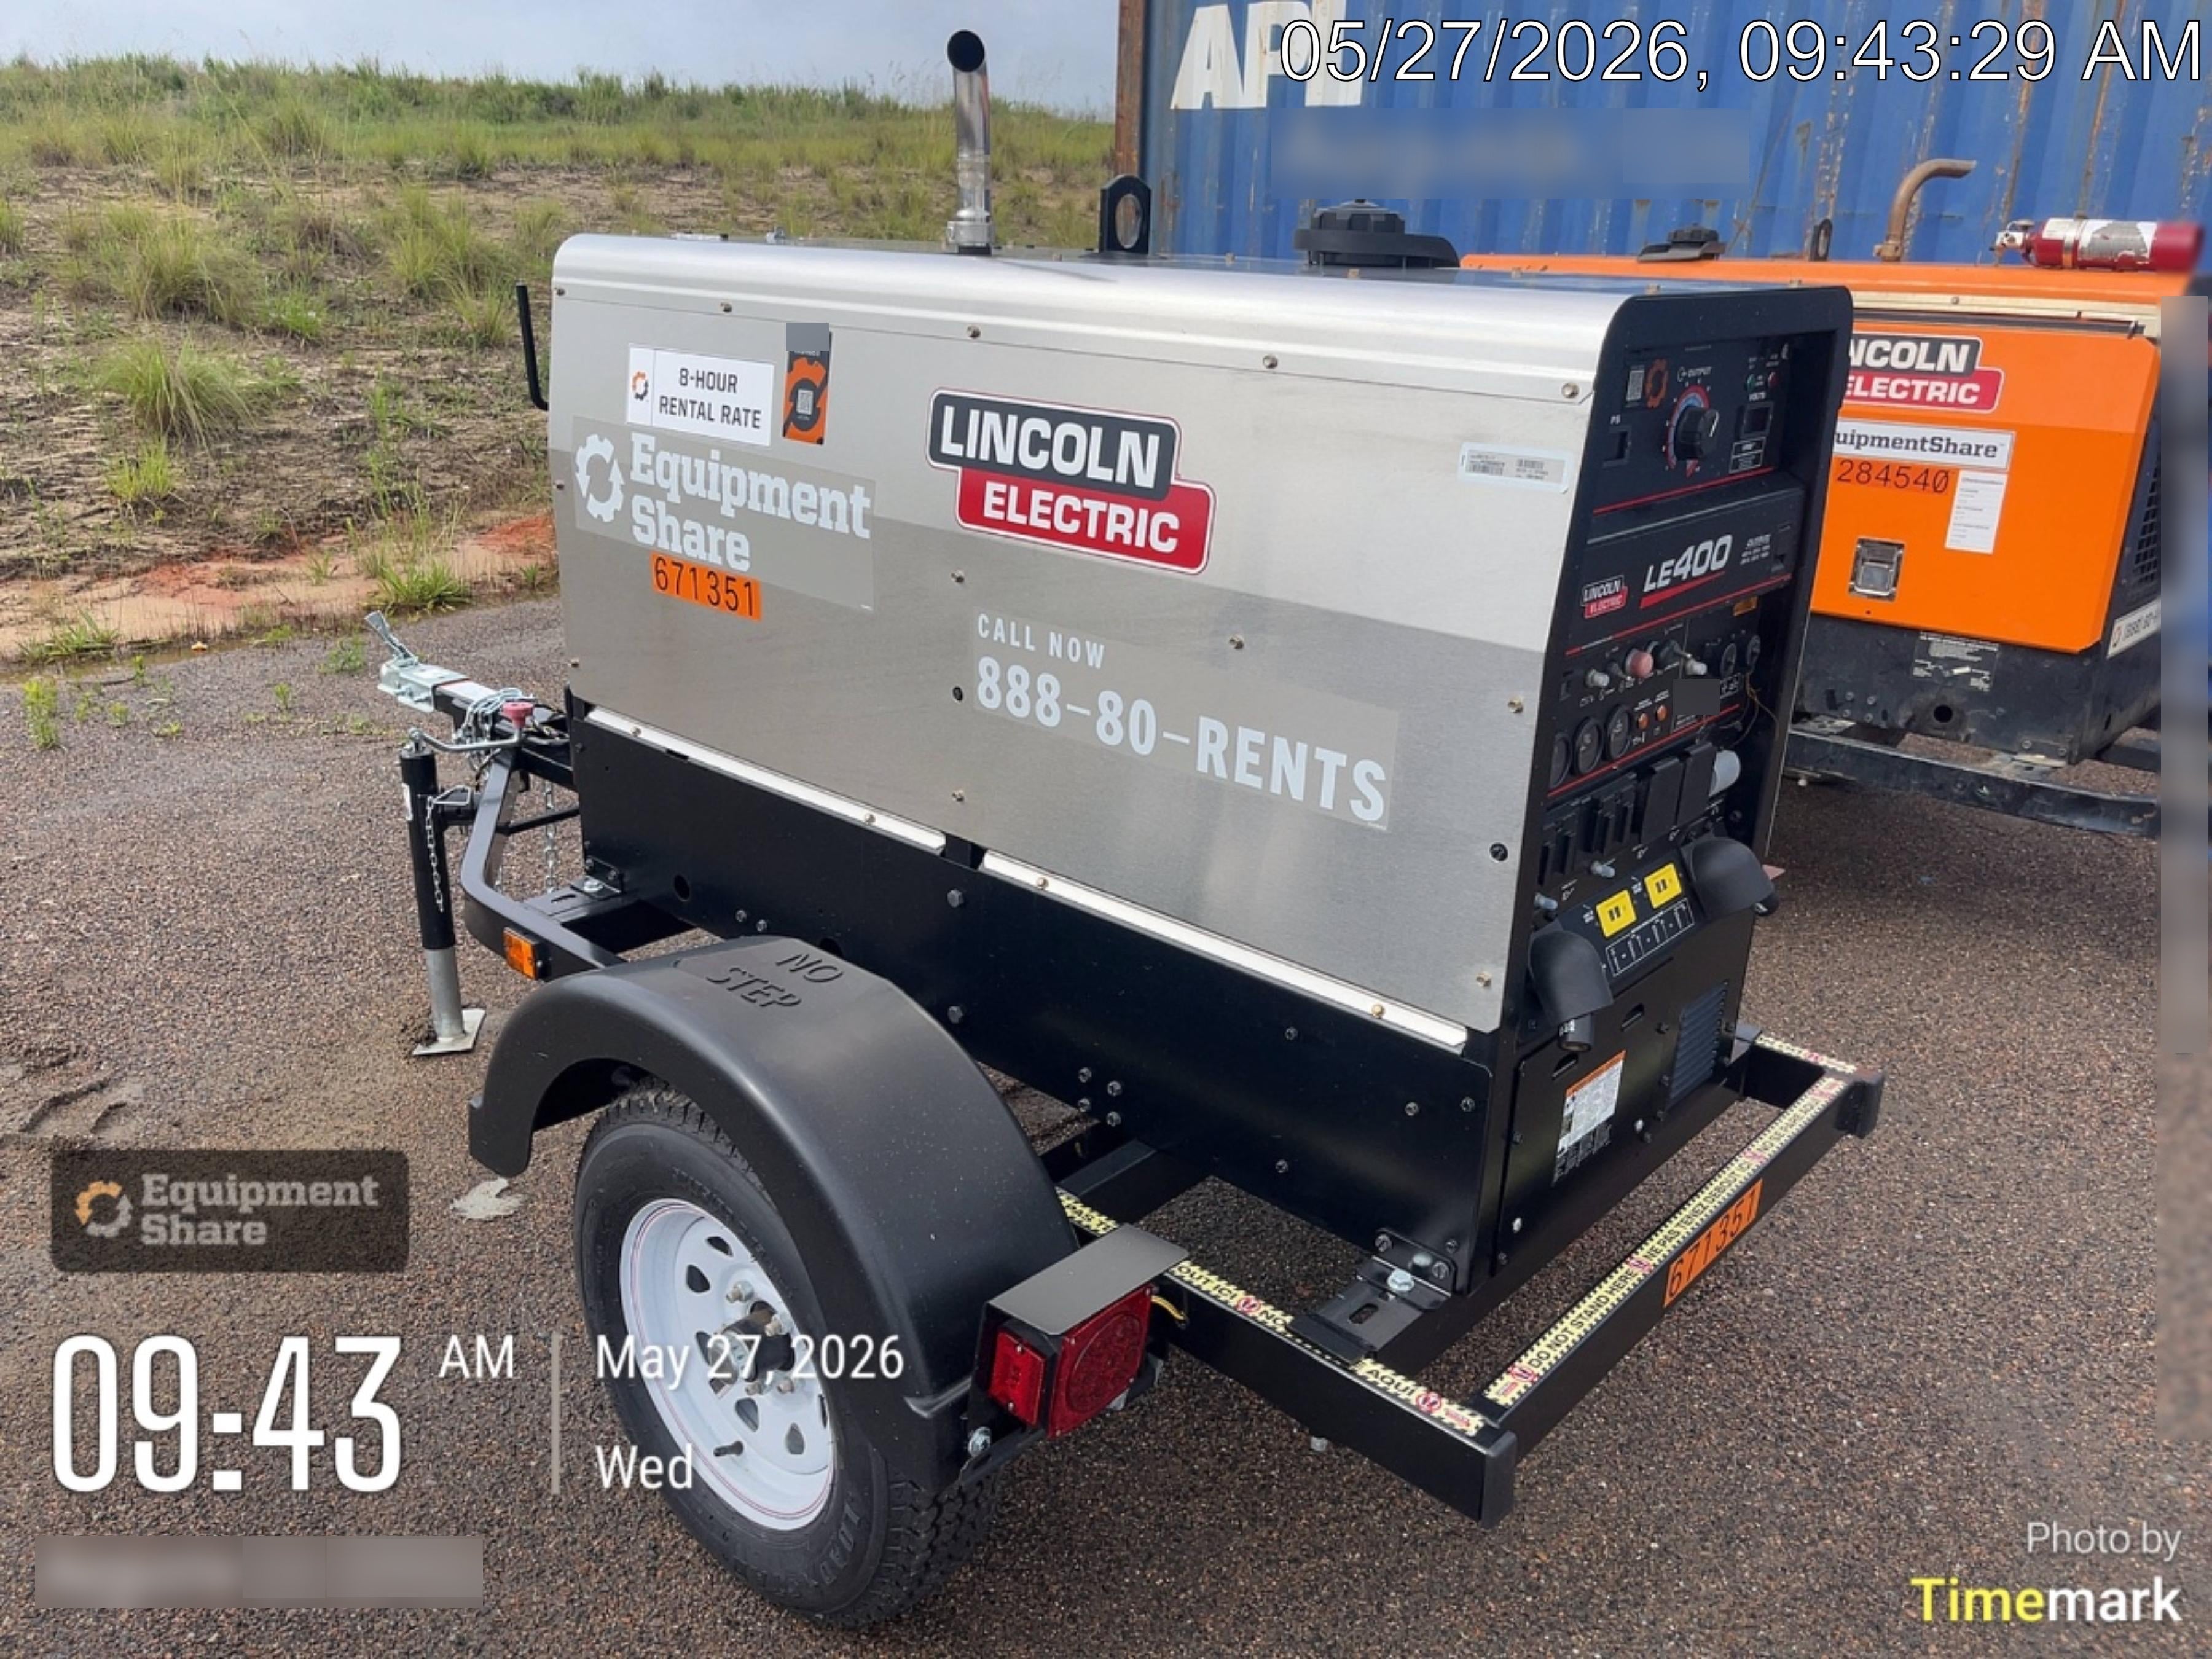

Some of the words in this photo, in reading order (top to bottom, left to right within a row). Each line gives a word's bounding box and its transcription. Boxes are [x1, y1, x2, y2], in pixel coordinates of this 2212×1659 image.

[680, 367, 737, 394] 8-HOUR
[1849, 339, 1969, 372] NCOLN
[659, 396, 715, 423] RENTAL
[721, 405, 761, 429] RATE
[940, 406, 1160, 488] LINCOLN
[1835, 429, 1998, 458] uipmentShare
[630, 433, 871, 539] Equipment
[1837, 459, 1950, 494] 284540
[631, 495, 750, 572] Share
[984, 481, 1180, 553] ELECTRIC
[655, 556, 753, 616] 671351
[1583, 579, 1622, 602] LINCOLN
[1644, 534, 1733, 592] LE400
[978, 614, 1035, 652] CALL
[1049, 632, 1105, 669] NOW
[978, 656, 1386, 822] 888-80-RENTS
[707, 967, 802, 1007] STEP
[776, 954, 844, 983] NO
[1669, 1189, 1756, 1297] 671351
[1528, 1351, 1551, 1368] DO
[1550, 1328, 1575, 1351] NOT
[1571, 1295, 1610, 1330] STAND
[1609, 1268, 1639, 1296] HERE
[1366, 1368, 1416, 1397] AQUI
